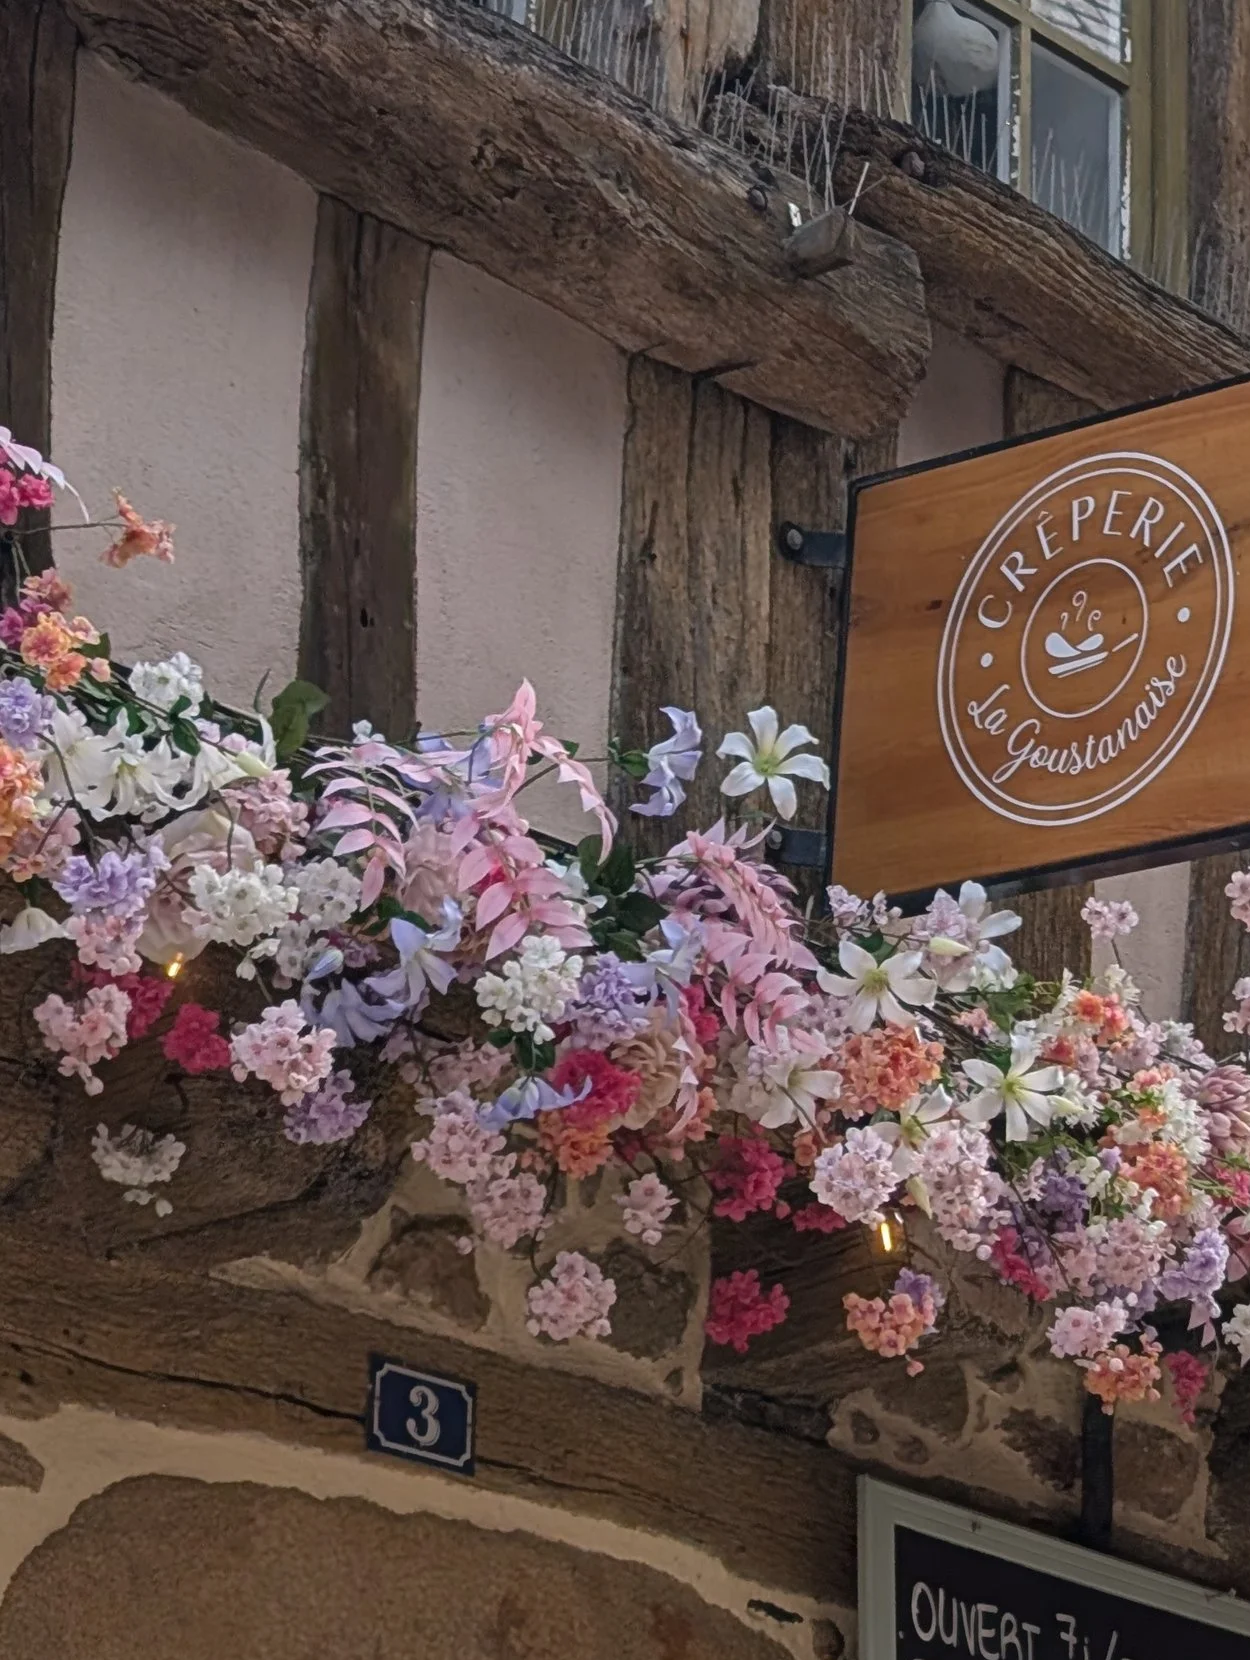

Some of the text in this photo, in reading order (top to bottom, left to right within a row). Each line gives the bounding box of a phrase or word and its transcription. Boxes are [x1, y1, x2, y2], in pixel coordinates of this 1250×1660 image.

[977, 489, 1204, 629] CRÊPERIE
[967, 654, 1187, 784] La Goustanaise
[406, 1385, 440, 1446] 3
